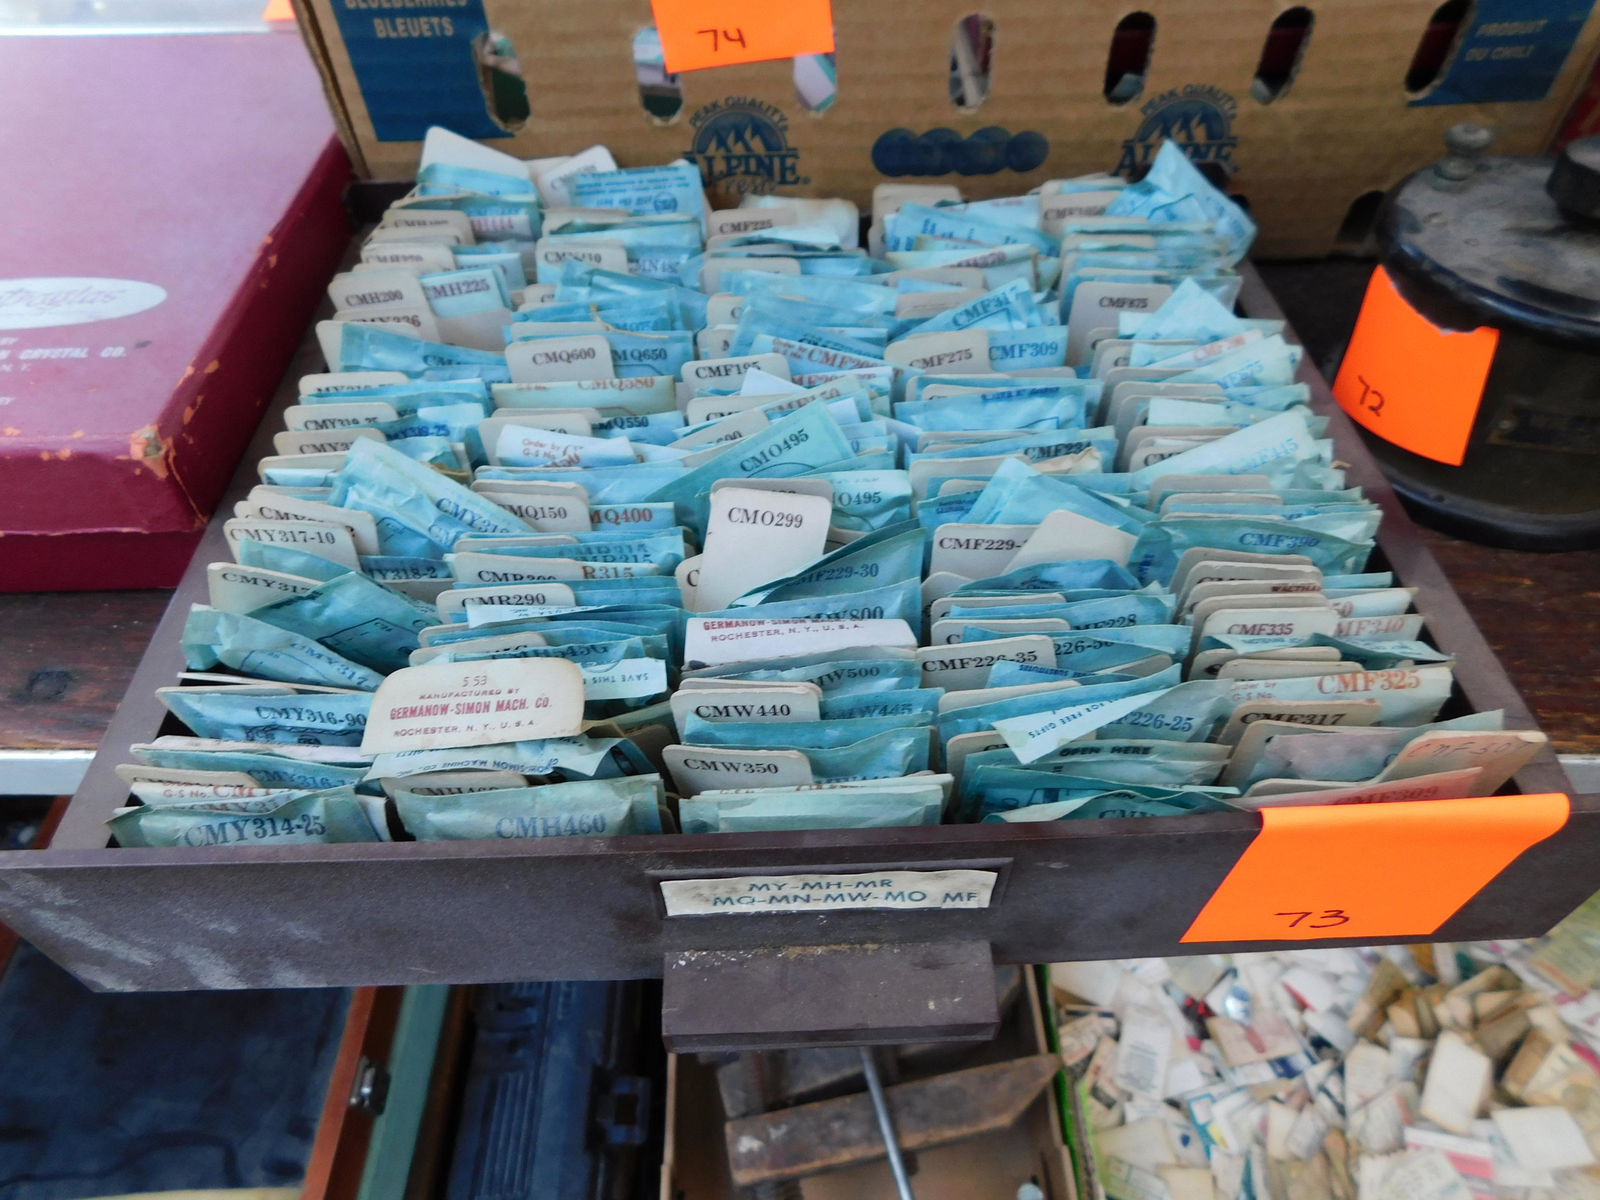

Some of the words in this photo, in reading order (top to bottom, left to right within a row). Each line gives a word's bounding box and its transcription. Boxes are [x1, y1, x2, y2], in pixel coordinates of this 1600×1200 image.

[373, 16, 455, 38] BLEUETS
[697, 28, 747, 51] 74
[532, 347, 596, 365] CMQ600
[1357, 375, 1386, 417] 72
[739, 428, 810, 474] CMO495
[727, 506, 804, 529] CMO299
[229, 528, 336, 545] CMY317-10
[711, 629, 785, 642] ROCHESTER,
[1227, 622, 1293, 636] CMF335
[1317, 670, 1421, 695] CMF325
[255, 705, 367, 727] CMY316-90
[390, 701, 491, 720] GERMANOW-SIMON
[497, 698, 529, 713] MACH.
[535, 696, 552, 709] CO.
[695, 704, 791, 719] CMW440
[1240, 712, 1346, 726] CMF317
[1058, 746, 1104, 757] OPEN
[1110, 746, 1155, 755] HERE
[684, 757, 779, 774] CMW350
[184, 813, 327, 847] CMY314-25
[495, 814, 607, 840] CMH460
[747, 878, 893, 892] MY-MH-MR
[942, 891, 978, 903] MF
[1273, 909, 1350, 929] 73
